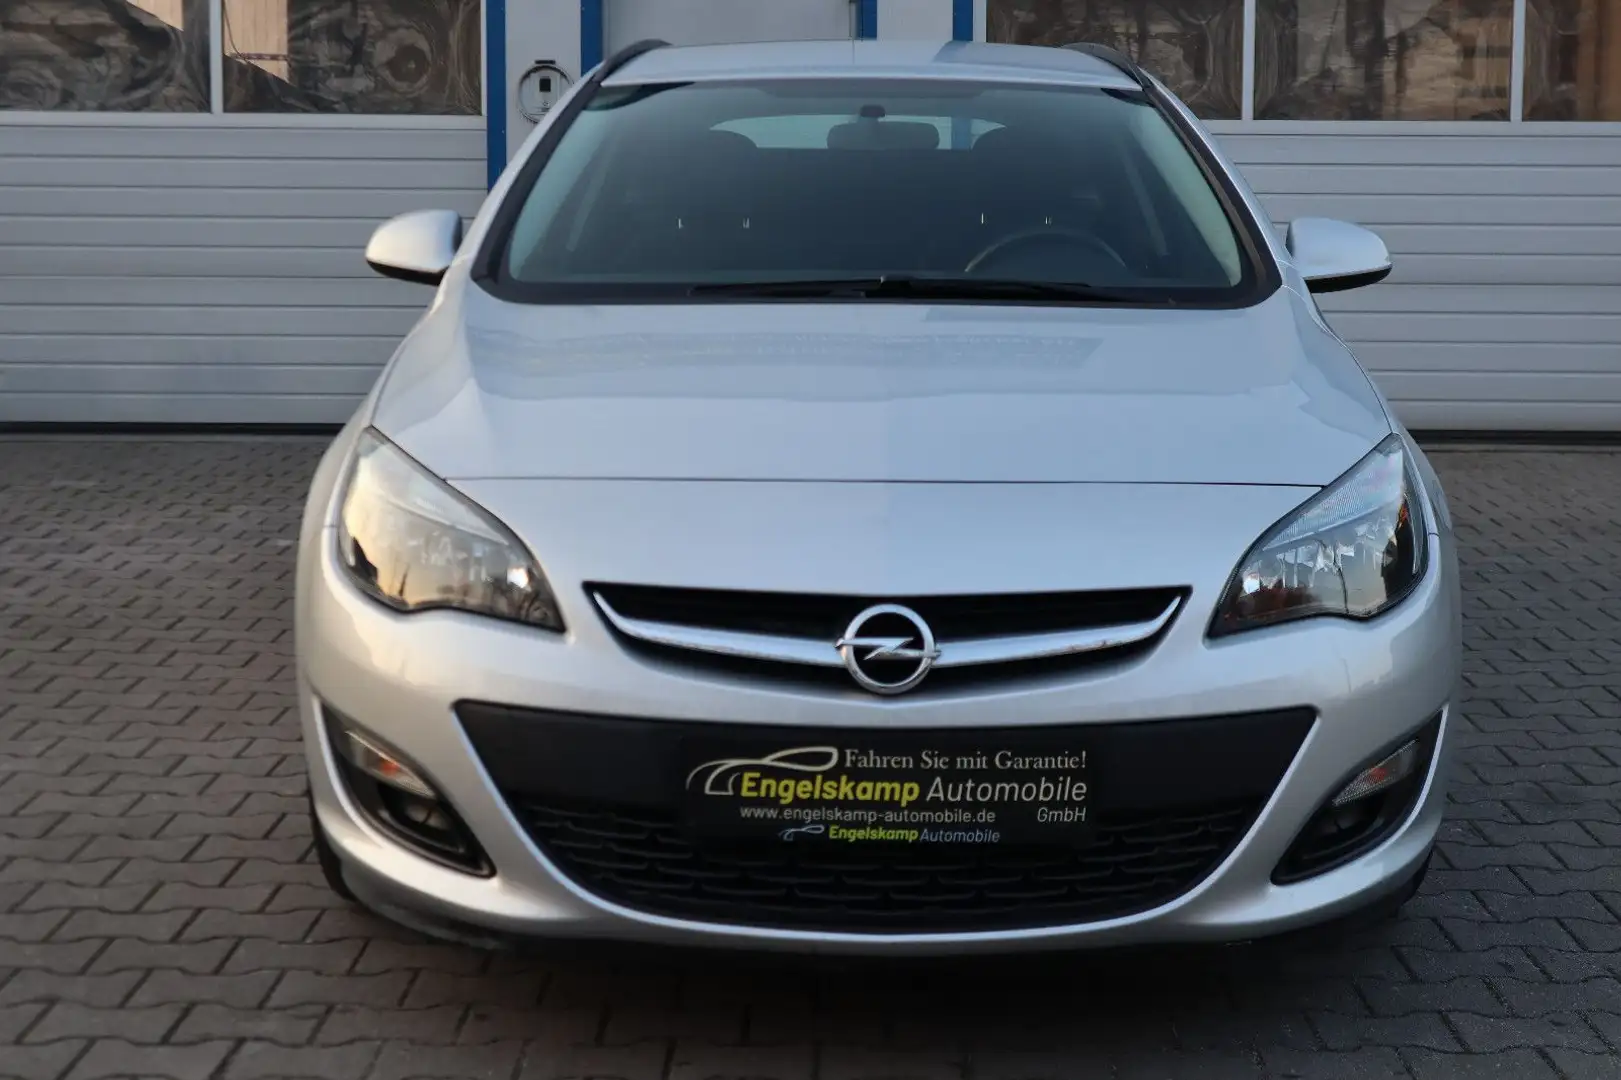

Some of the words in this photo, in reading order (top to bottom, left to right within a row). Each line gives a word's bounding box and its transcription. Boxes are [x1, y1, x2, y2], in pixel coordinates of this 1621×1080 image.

[844, 749, 914, 769] Fahren
[920, 750, 949, 769] Sie
[956, 750, 988, 769] mit
[995, 749, 1087, 769] Garantie!
[740, 771, 920, 806] Engelskamp
[926, 776, 1088, 802] Automobile
[740, 806, 996, 823] www.engelskamp-automobile.de
[1036, 807, 1087, 822] GmbH
[828, 825, 919, 842] Engelskamp
[920, 828, 1000, 843] Automobile
